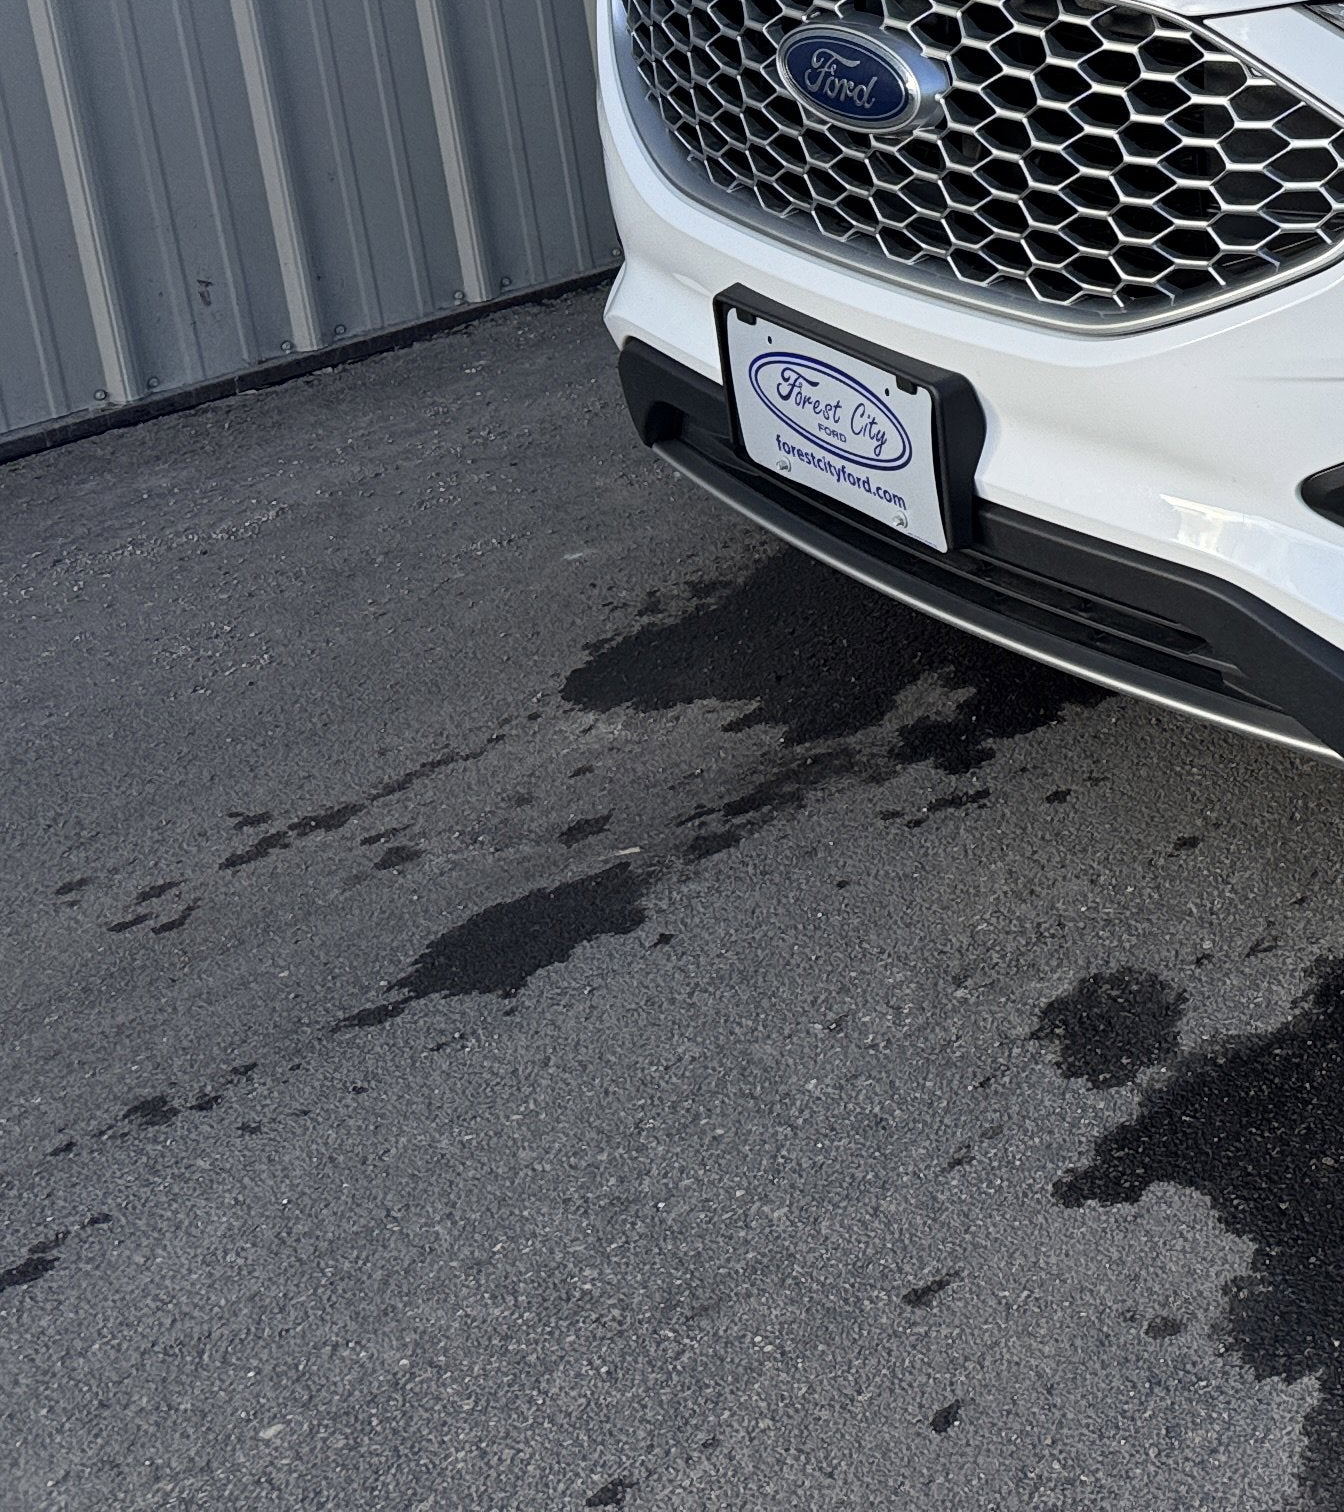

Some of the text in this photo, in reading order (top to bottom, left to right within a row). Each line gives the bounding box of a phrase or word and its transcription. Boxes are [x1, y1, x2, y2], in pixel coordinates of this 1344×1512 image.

[804, 48, 878, 109] Ford
[776, 367, 888, 456] Forest City
[817, 422, 847, 444] FORD
[775, 434, 907, 511] forestcityford.com
